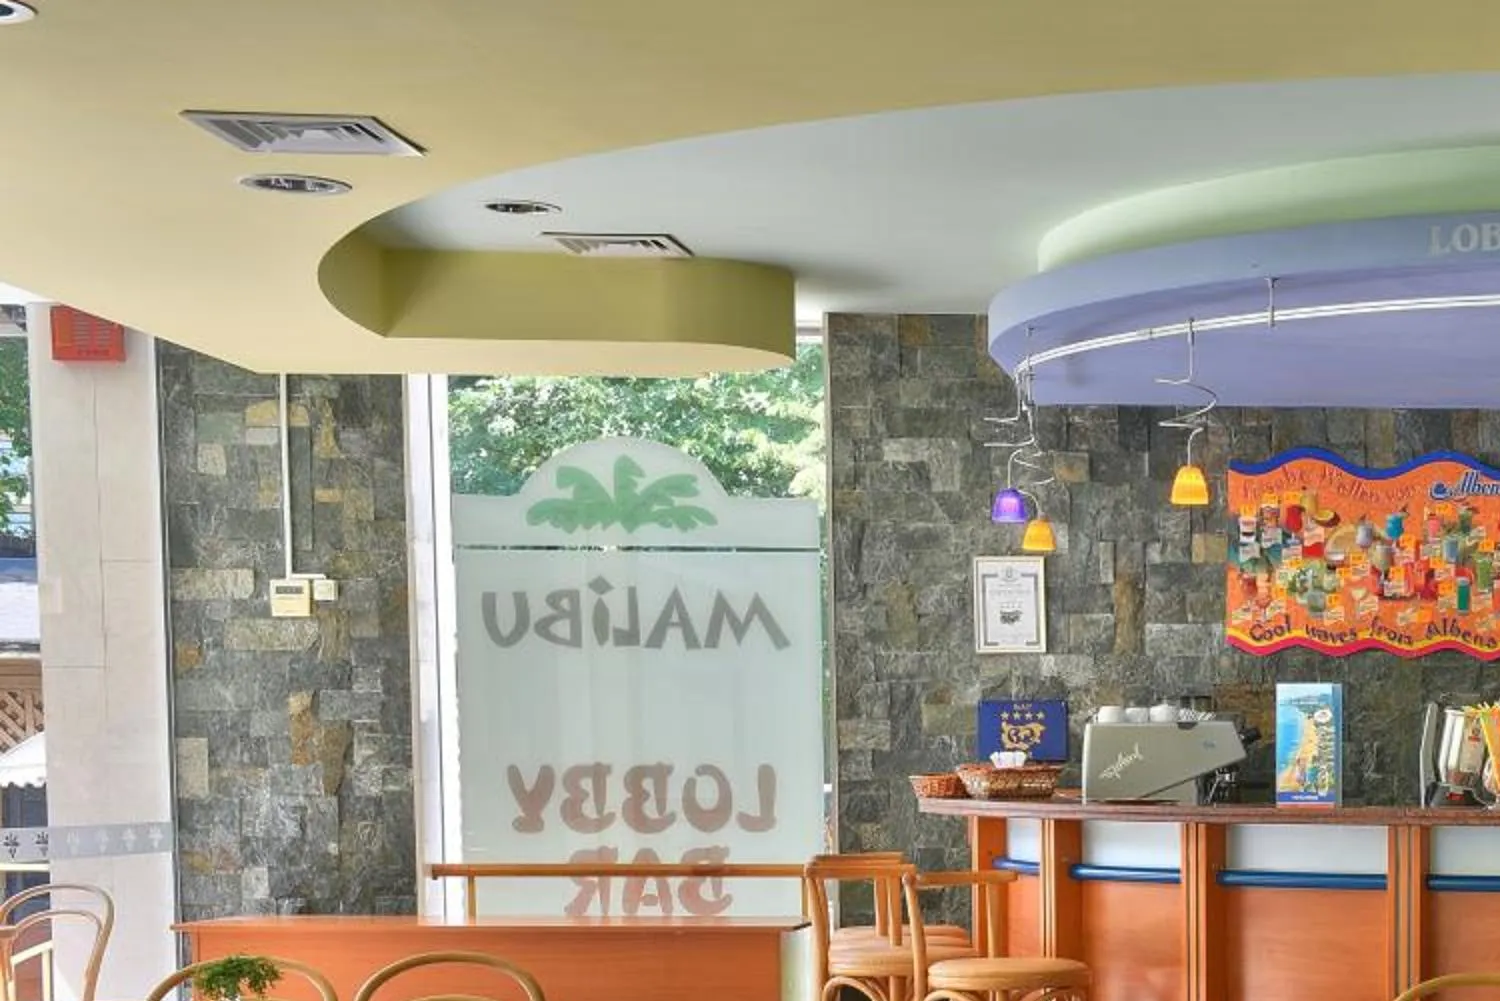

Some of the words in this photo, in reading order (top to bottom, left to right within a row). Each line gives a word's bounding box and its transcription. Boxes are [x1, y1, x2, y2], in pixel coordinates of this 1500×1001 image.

[1249, 613, 1291, 641] Cool
[1305, 623, 1357, 644] waves
[1370, 615, 1413, 646] from
[1425, 617, 1497, 648] Albena
